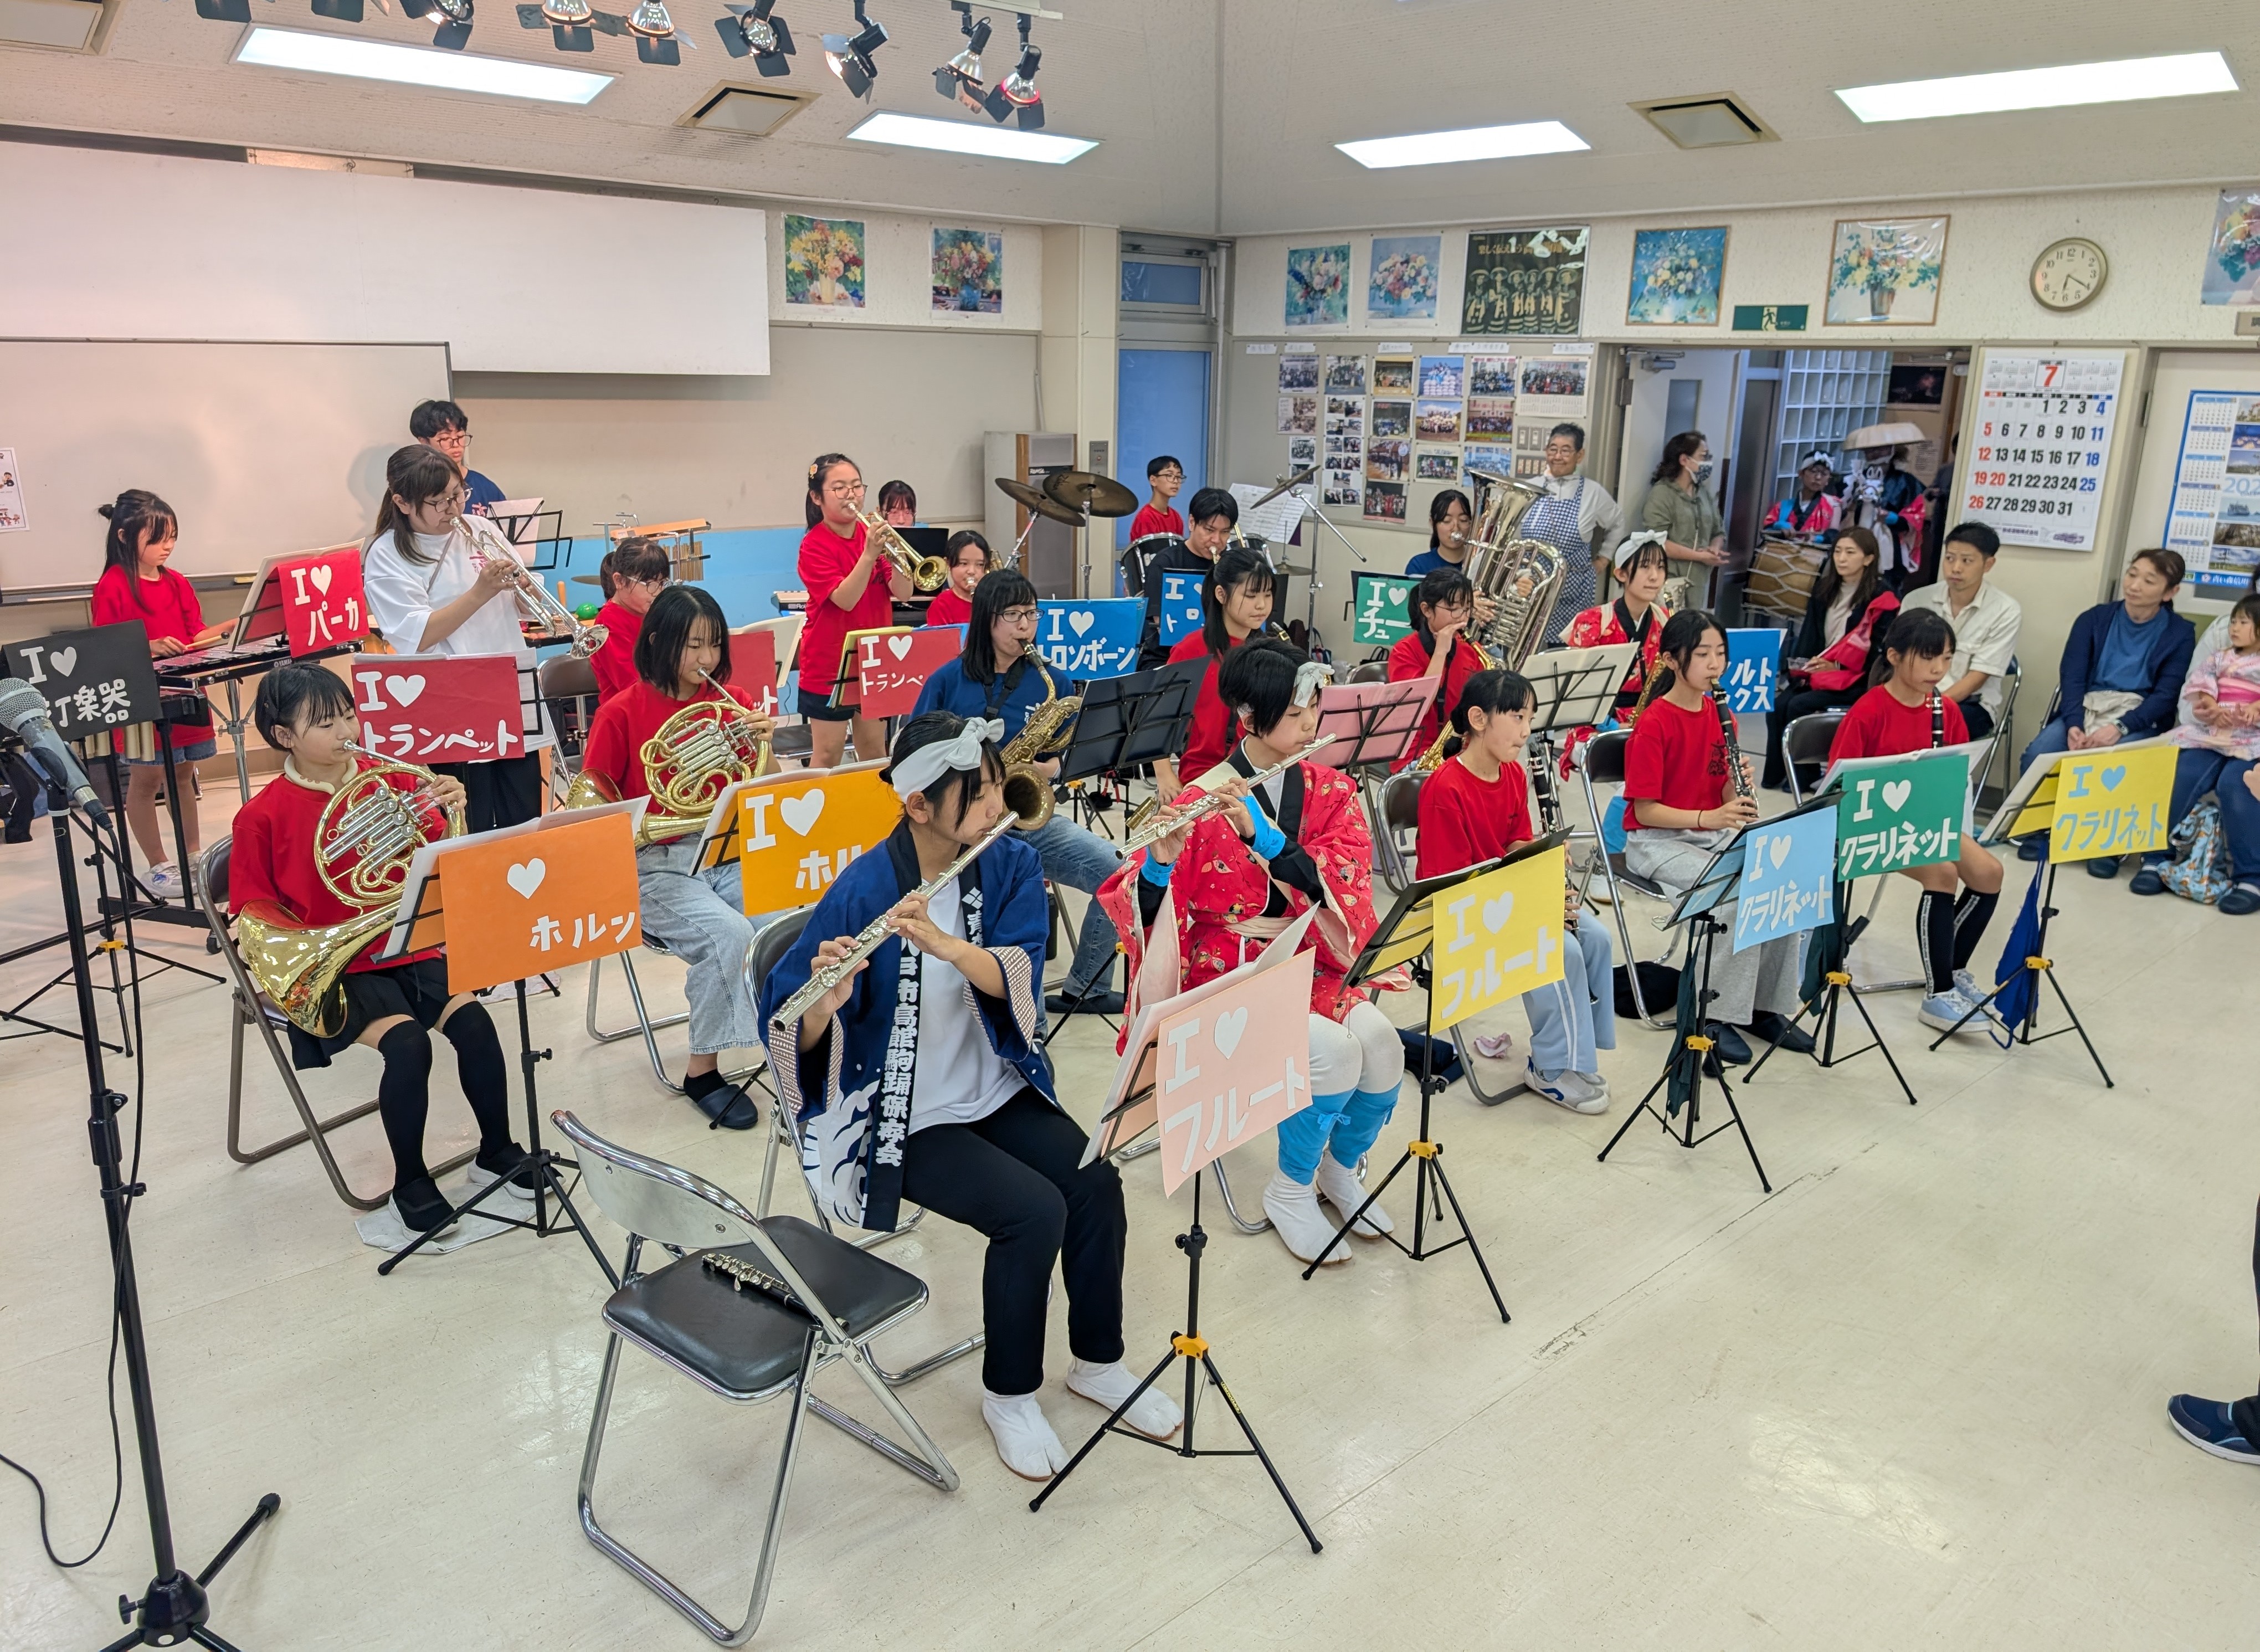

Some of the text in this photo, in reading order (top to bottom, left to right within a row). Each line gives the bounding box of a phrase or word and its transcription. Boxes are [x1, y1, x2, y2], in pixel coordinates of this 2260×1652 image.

[2043, 365, 2058, 387] 7
[2042, 400, 2105, 415] 1 2 3 4
[1983, 422, 2104, 441] 5 6 7 8 9 10 11
[1978, 447, 2100, 466] 12 13 14 15 16 17 18
[1974, 471, 2097, 492] 19 20 21 22 23 24 25
[1968, 495, 1985, 509] 26
[1985, 496, 2002, 510] 27
[2002, 497, 2019, 512] 28
[2020, 499, 2037, 512] 29
[2038, 500, 2055, 514] 30
[2057, 501, 2073, 516] 31
[308, 597, 359, 646] パーカ
[363, 720, 518, 759] トランペット
[1840, 817, 1958, 877] クラリネット
[2056, 803, 2163, 851] クラリネット
[1738, 874, 1832, 940] クラリネット
[530, 911, 635, 952] ホルン
[1441, 925, 1557, 1020] フルート
[1164, 1055, 1305, 1173] フルート
